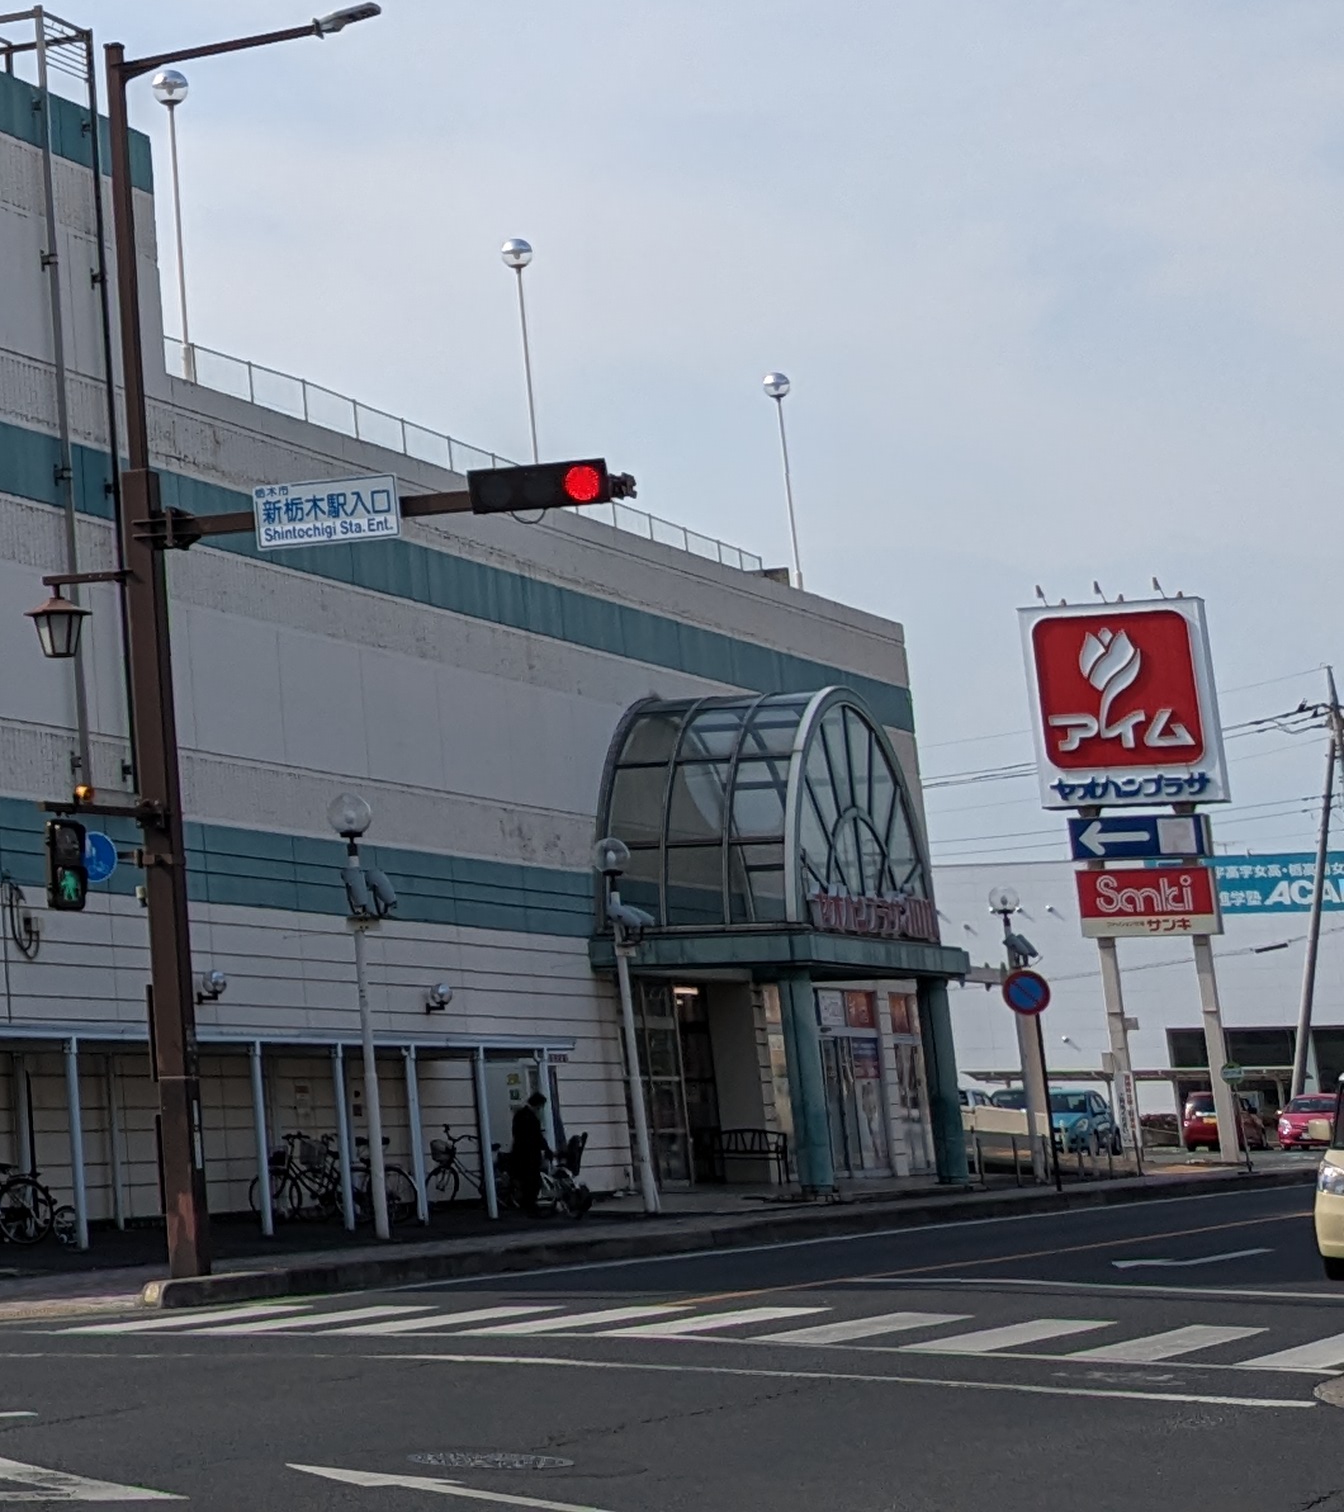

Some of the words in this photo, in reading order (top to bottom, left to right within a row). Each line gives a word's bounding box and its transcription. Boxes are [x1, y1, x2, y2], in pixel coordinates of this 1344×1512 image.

[255, 485, 289, 499] 栃木市
[262, 489, 391, 525] 新栃木駅入口
[264, 522, 337, 543] Shintochigi
[340, 520, 366, 535] Sta.
[367, 516, 394, 533] Ent.
[1048, 708, 1197, 752] アイム
[1049, 771, 1211, 802] ヤオハンプラザ
[1095, 874, 1194, 914] Sanki
[1264, 878, 1344, 906] ACA
[1147, 917, 1192, 932] サンキ
